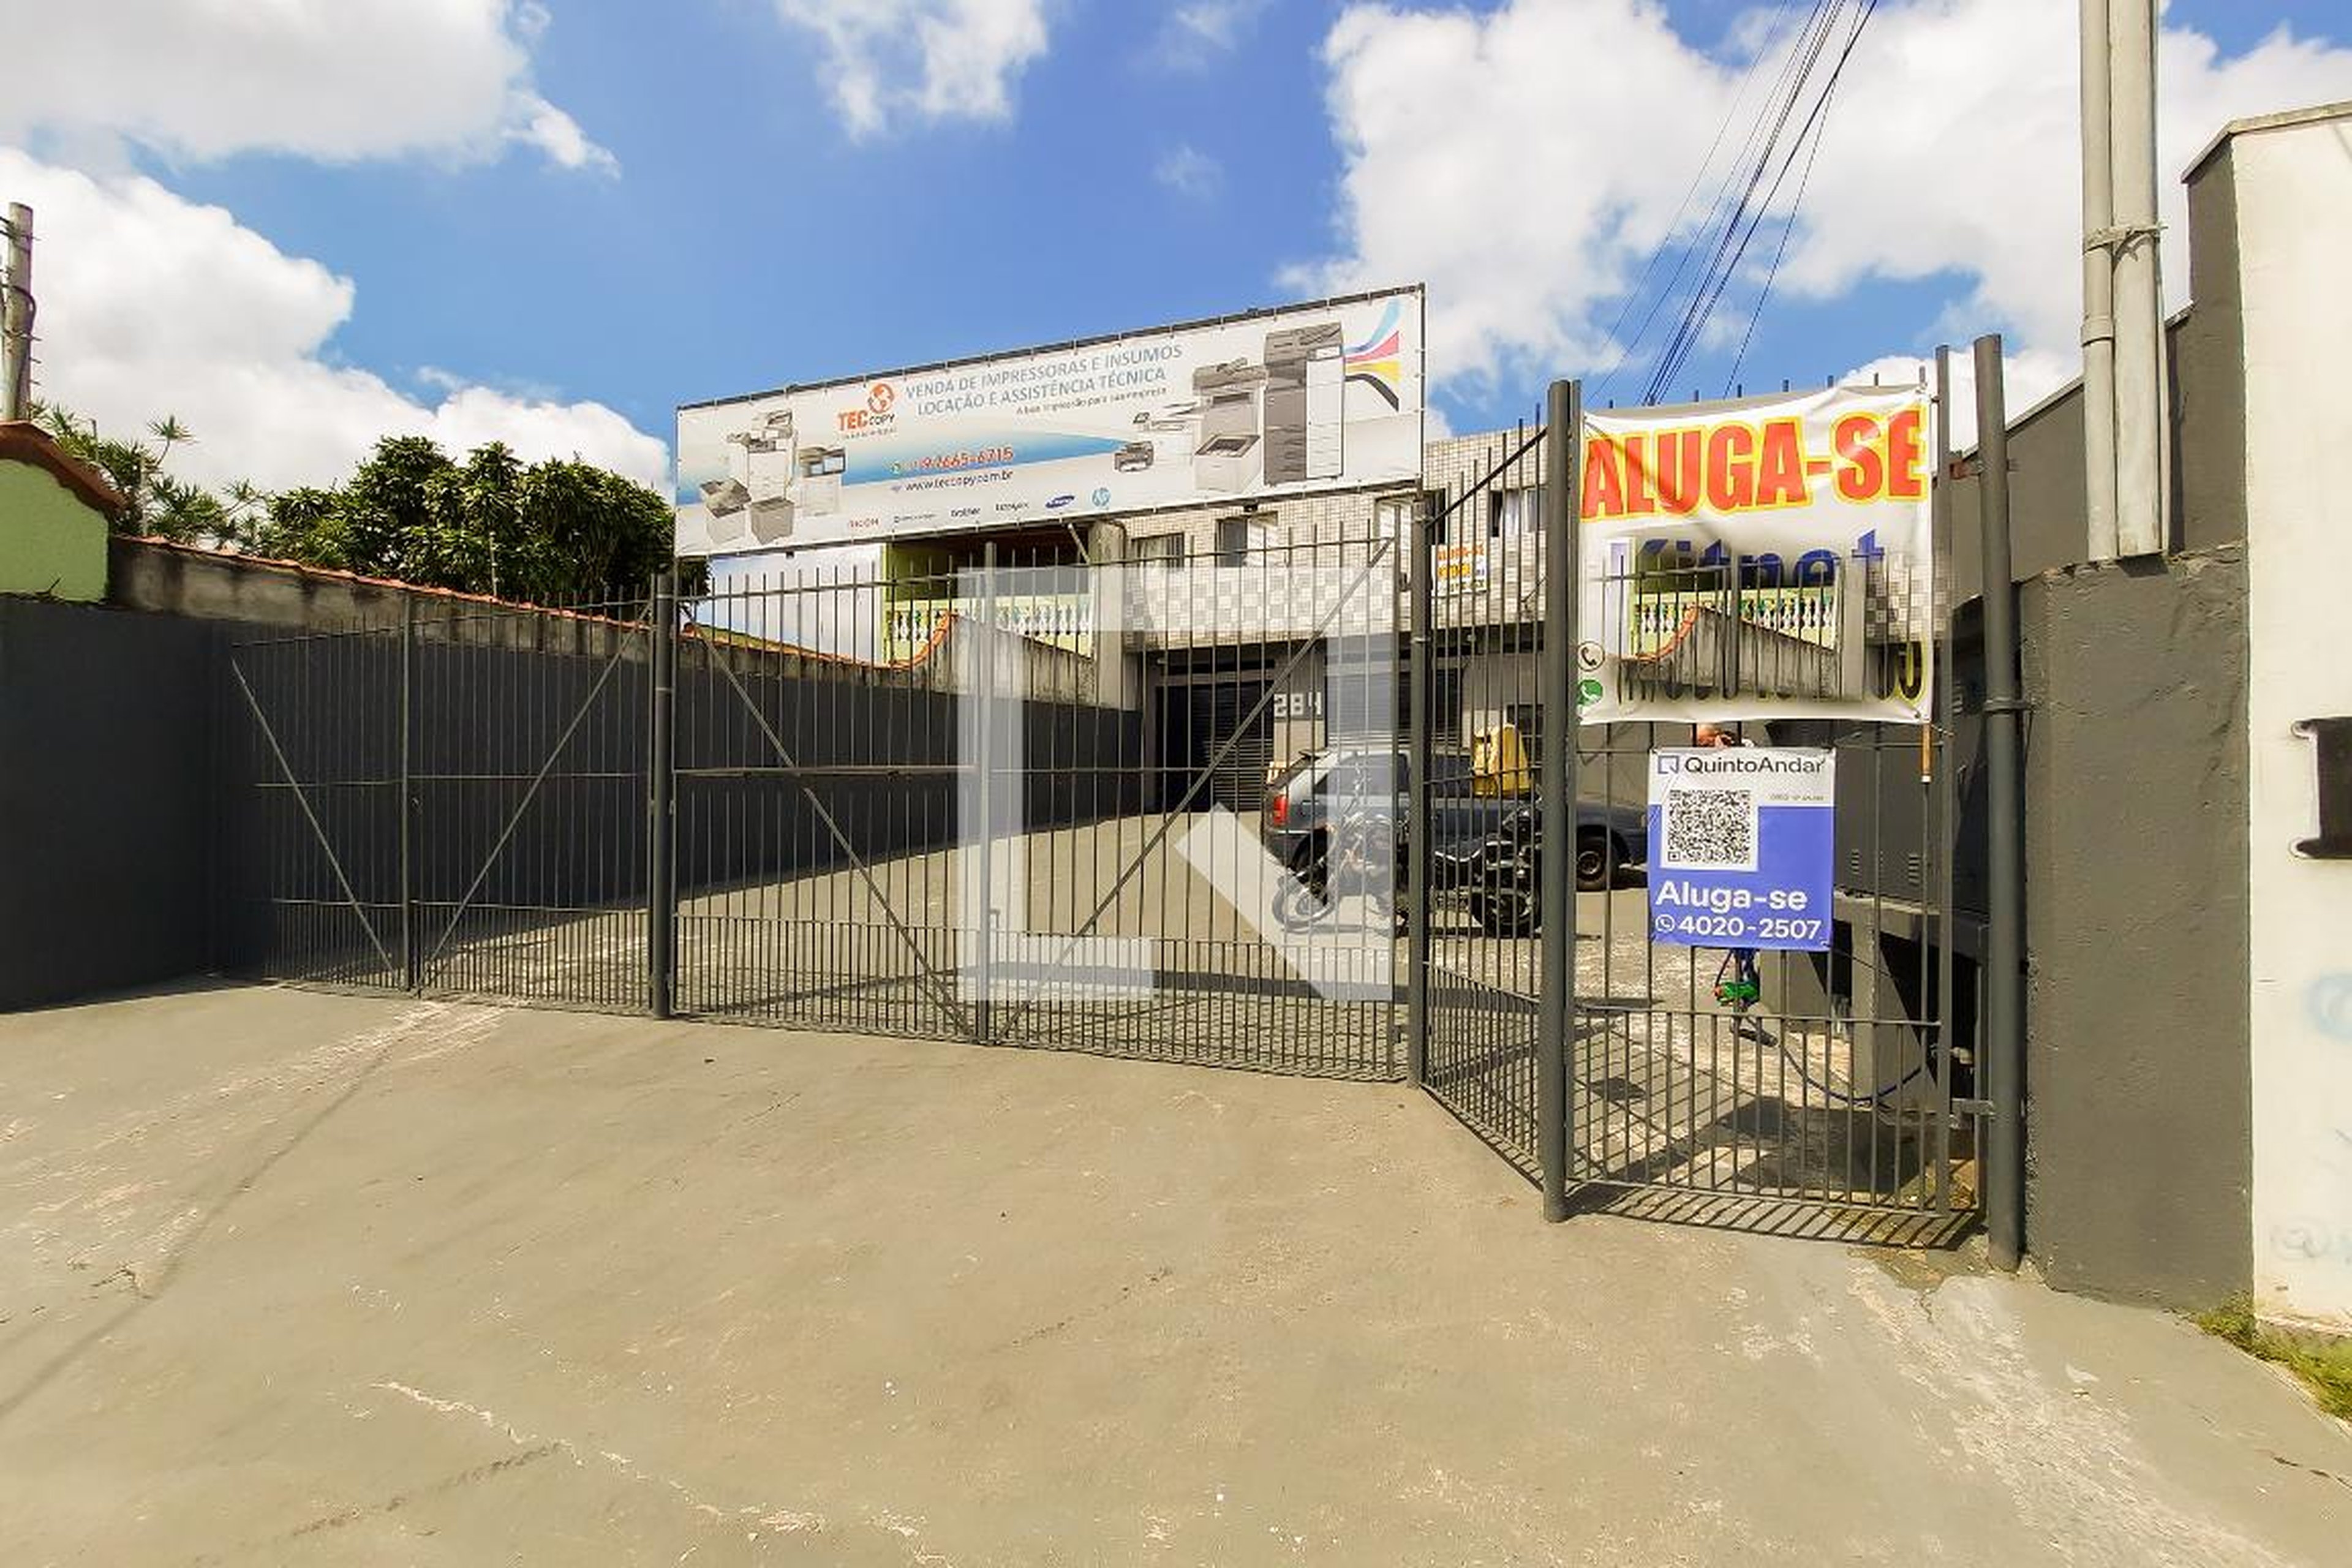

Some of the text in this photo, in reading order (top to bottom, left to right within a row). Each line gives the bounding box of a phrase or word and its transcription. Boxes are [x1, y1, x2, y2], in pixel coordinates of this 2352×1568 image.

[907, 345, 1183, 398] VENDA DE IMPRESSORAS E INSUMOS
[918, 368, 1166, 415] LOCAÇÃO E ASSISTÊNCIA TÉCNICA
[1581, 407, 1925, 521] ALUGA-SE
[1684, 756, 1826, 774] QuintoAndar
[1656, 880, 1807, 913] Aluga-se
[1679, 916, 1822, 940] 4020-2507
